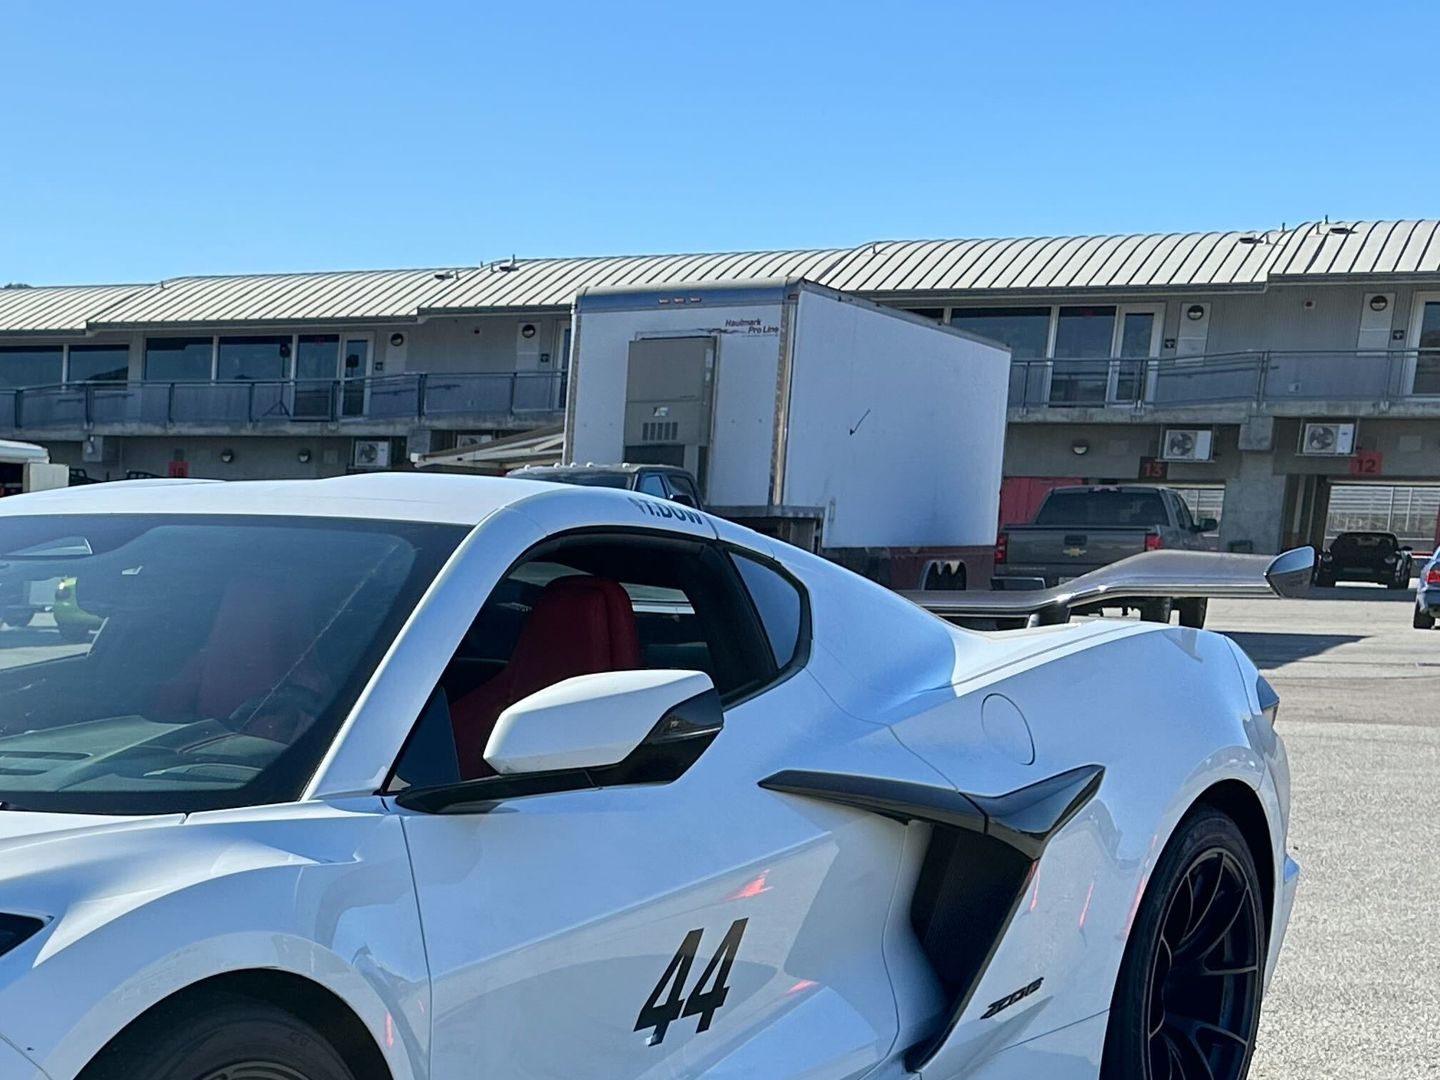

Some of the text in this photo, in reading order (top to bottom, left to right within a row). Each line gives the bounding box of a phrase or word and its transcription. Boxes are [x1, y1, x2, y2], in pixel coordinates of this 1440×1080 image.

[725, 318, 761, 327] Haulmark
[748, 325, 779, 334] Pro Line
[1144, 462, 1164, 477] 13
[1357, 459, 1376, 473] 12
[633, 917, 749, 1047] 44
[980, 977, 1044, 1020] Z06
